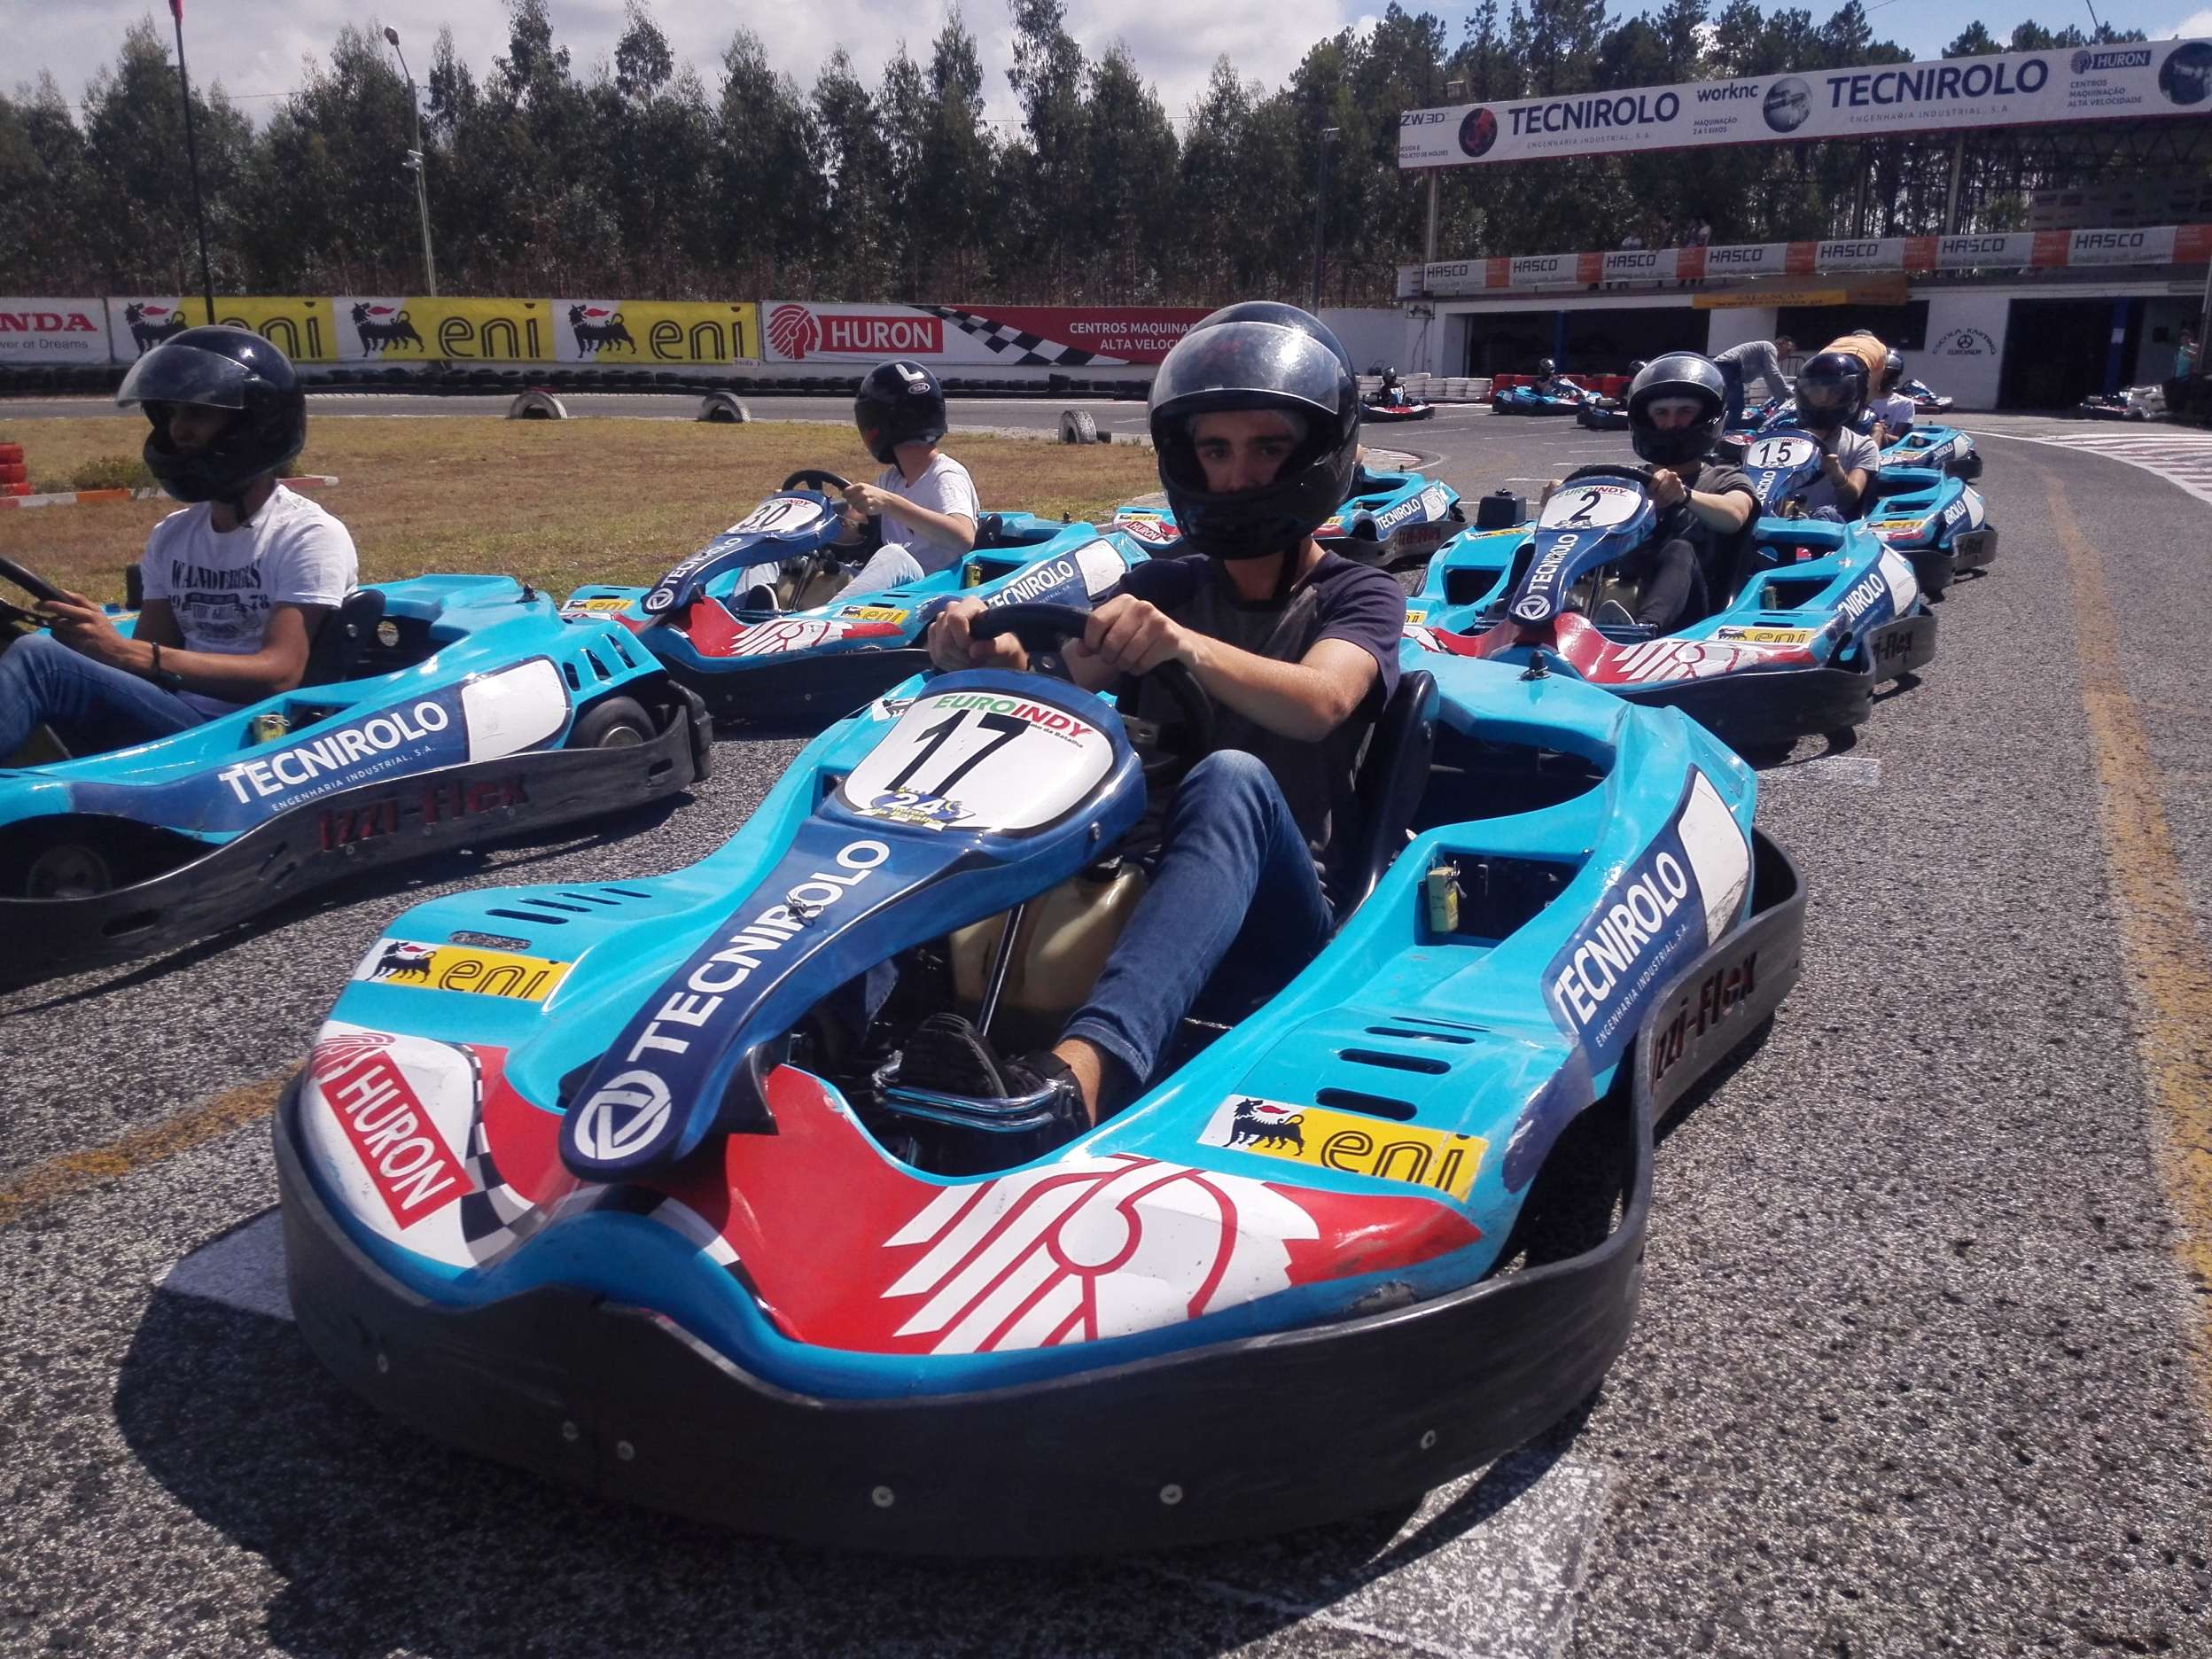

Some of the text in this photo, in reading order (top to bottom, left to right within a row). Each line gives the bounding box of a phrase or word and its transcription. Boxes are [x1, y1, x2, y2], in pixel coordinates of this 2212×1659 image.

[2097, 52, 2147, 67] HURON
[1697, 82, 1759, 103] worknc
[1826, 58, 2049, 108] TECNIROLO
[2069, 79, 2107, 89] CENTROS
[1508, 91, 1680, 136] TECNIROLO
[1850, 112, 1915, 123] ENGENHARIA
[1820, 243, 1879, 259] HASCO
[1943, 238, 2006, 253] HASCO
[2075, 233, 2145, 249] HASCO
[1513, 259, 1558, 274] HASCO
[1606, 253, 1657, 269] HASCO
[1709, 248, 1764, 263] HASCO
[1426, 264, 1468, 278] HASCO
[0, 313, 97, 331] NDA
[438, 302, 540, 360] eni
[649, 306, 744, 360] eni
[831, 320, 933, 349] HURON
[1070, 323, 1128, 334] CENTROS
[39, 339, 89, 349] Dreams
[1100, 339, 1133, 350] ALTA
[1759, 441, 1794, 467] 15
[1556, 487, 1629, 498] EUROINDY
[739, 503, 792, 529] 30
[1376, 499, 1421, 531] TECNIROLO
[1568, 491, 1601, 525] 2
[1130, 522, 1160, 541] HURON
[1527, 534, 1579, 594] TECNIROLO
[1755, 630, 1808, 643] eni
[931, 695, 1093, 736] EUROINDY
[219, 701, 449, 804] TECNIROLO
[884, 709, 1032, 798] 17
[272, 779, 344, 813] ENGENHARIA
[346, 755, 414, 783] INDUSTRIAL,
[882, 792, 946, 814] 24
[627, 840, 890, 1062] TECNIROLO
[1554, 852, 1688, 1035] TECNIROLO
[439, 959, 558, 1001] eni
[1595, 988, 1639, 1048] ENGENHARIA
[1637, 939, 1678, 992] INDUSTRIAL,
[337, 1066, 456, 1211] HURON
[1320, 1133, 1471, 1193] eni
